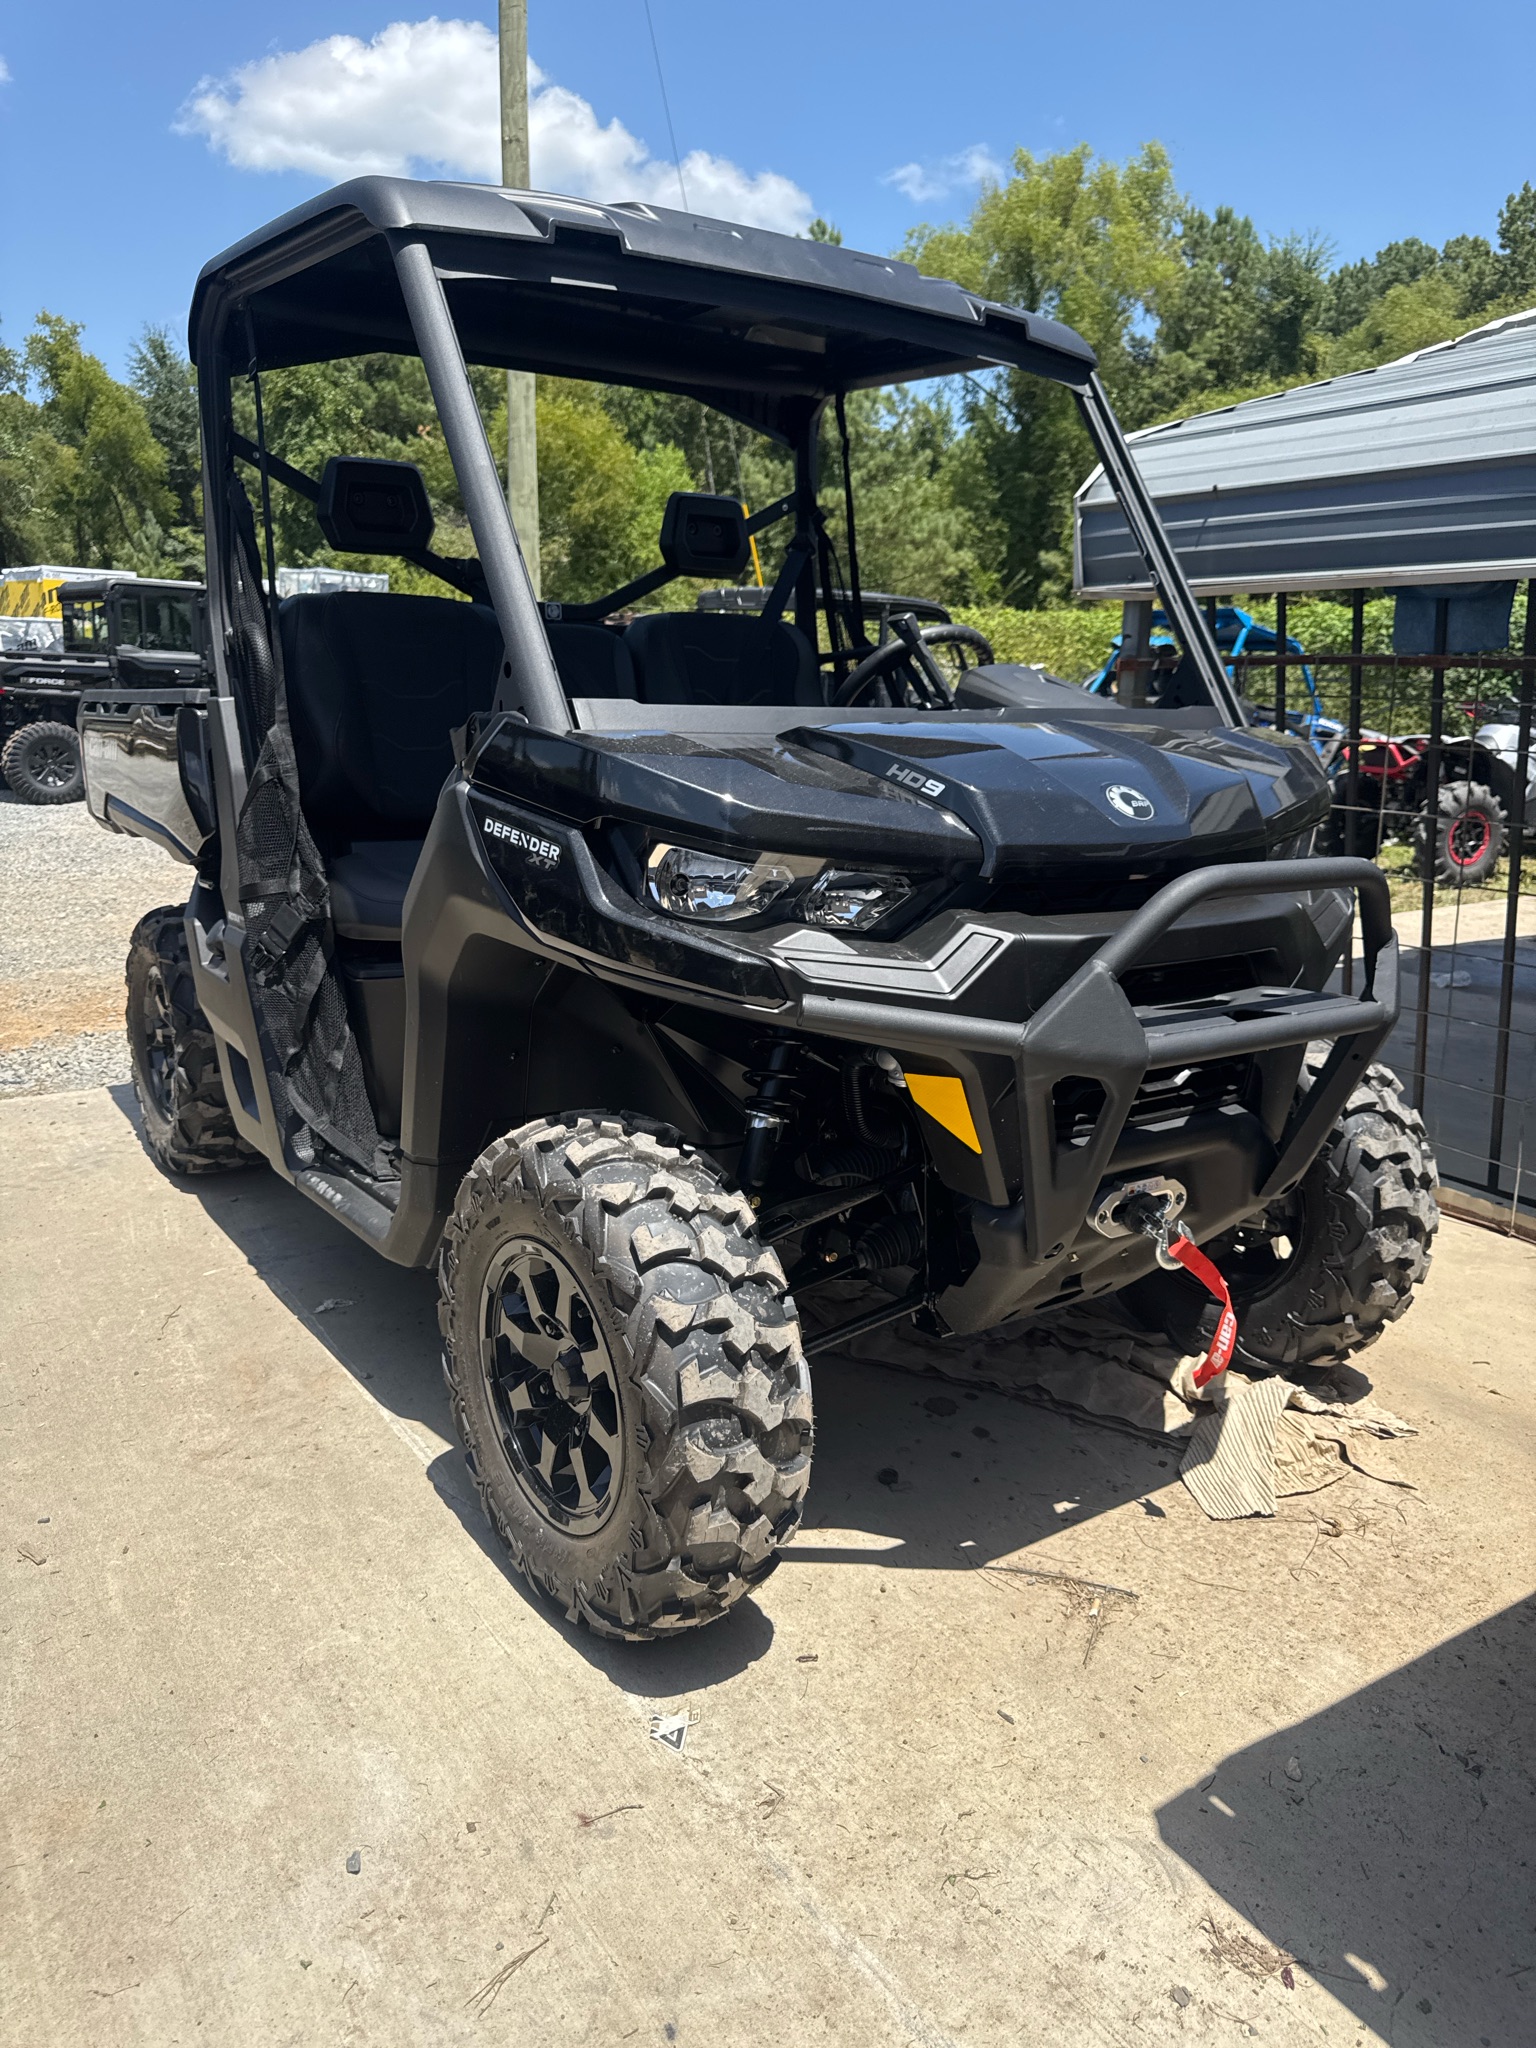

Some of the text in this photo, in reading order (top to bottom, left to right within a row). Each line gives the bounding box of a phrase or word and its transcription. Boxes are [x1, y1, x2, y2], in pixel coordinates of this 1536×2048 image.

[885, 763, 946, 797] HD9
[483, 818, 560, 861] DEFENDER
[528, 853, 557, 870] XT
